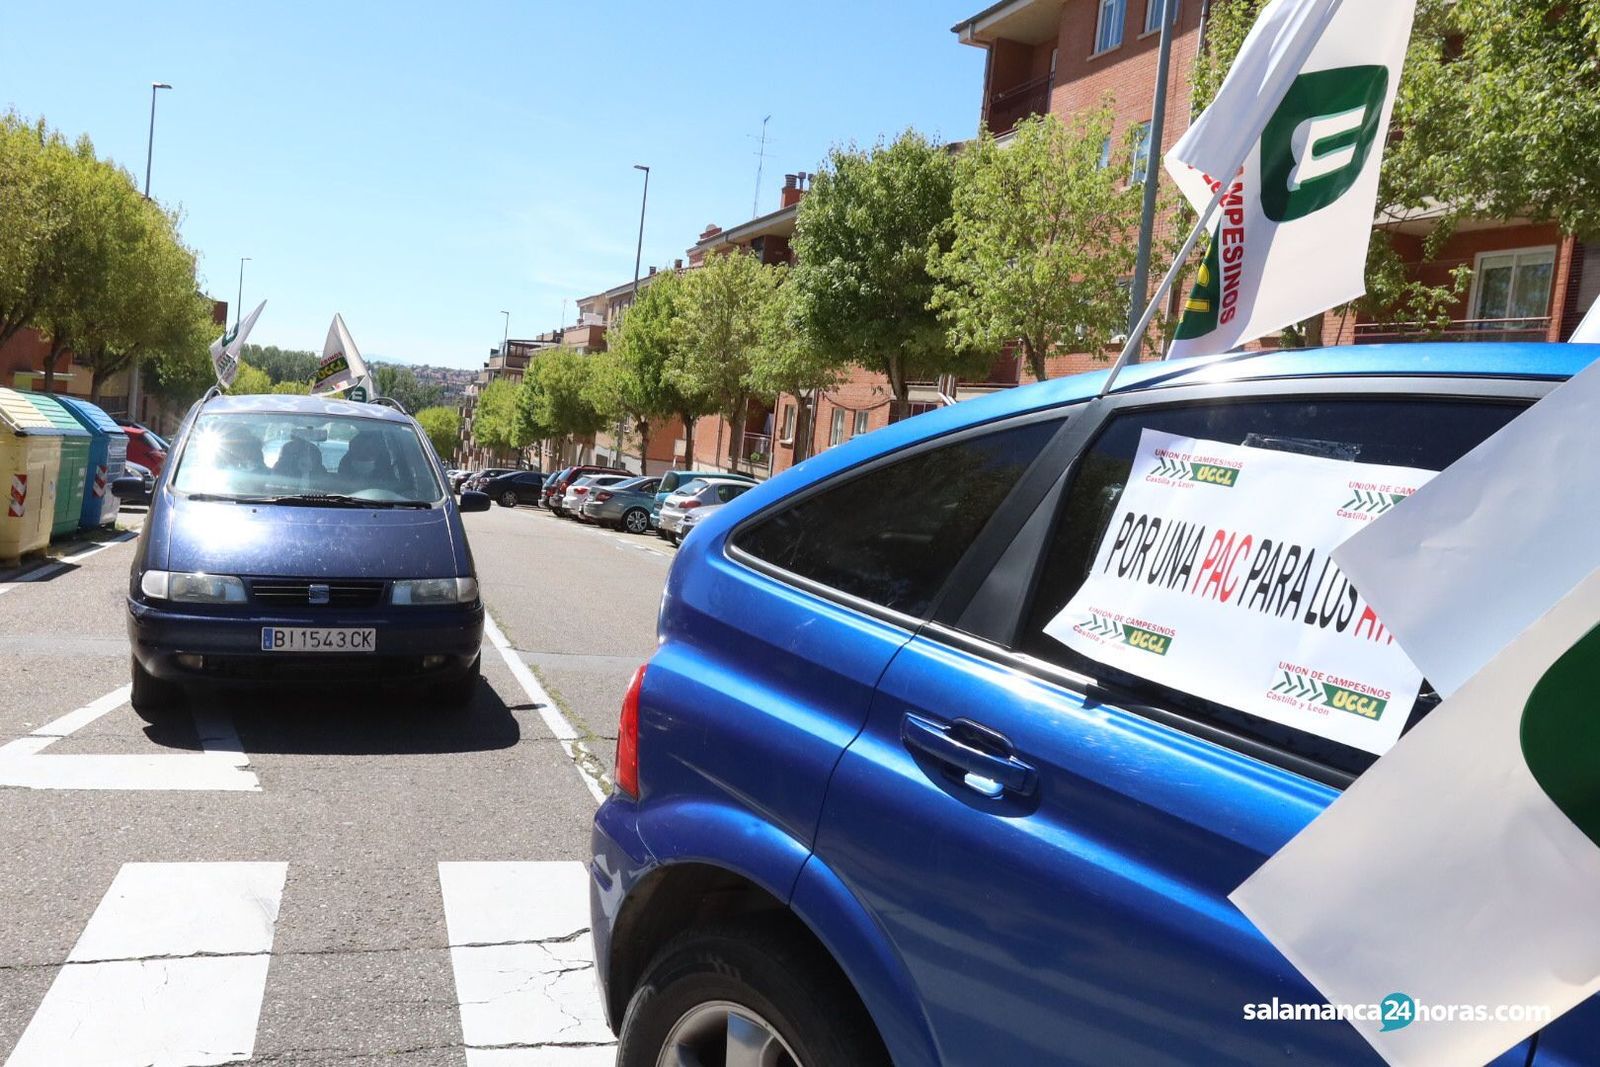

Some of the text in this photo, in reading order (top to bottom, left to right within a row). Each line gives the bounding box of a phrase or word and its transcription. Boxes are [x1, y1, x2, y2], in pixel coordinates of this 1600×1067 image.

[1193, 456, 1243, 469] CAMPESINOS
[1145, 475, 1170, 484] Castilla
[1197, 465, 1233, 485] UCCL
[1379, 485, 1392, 493] DE
[1337, 508, 1368, 521] Castilla
[1104, 512, 1162, 582] POR
[1147, 519, 1206, 592] UNA
[1191, 529, 1253, 602] PAC
[1237, 539, 1316, 621] PARA
[1304, 556, 1358, 633] LOS
[1073, 625, 1100, 642] Castilla
[1114, 614, 1125, 622] DE
[1125, 617, 1176, 637] CAMPESINOS
[1129, 630, 1165, 654] UCCL
[1311, 670, 1324, 680] DE
[1326, 675, 1391, 700] CAMPESINOS
[1266, 691, 1298, 706] Castilla
[1332, 689, 1378, 718] UCCL
